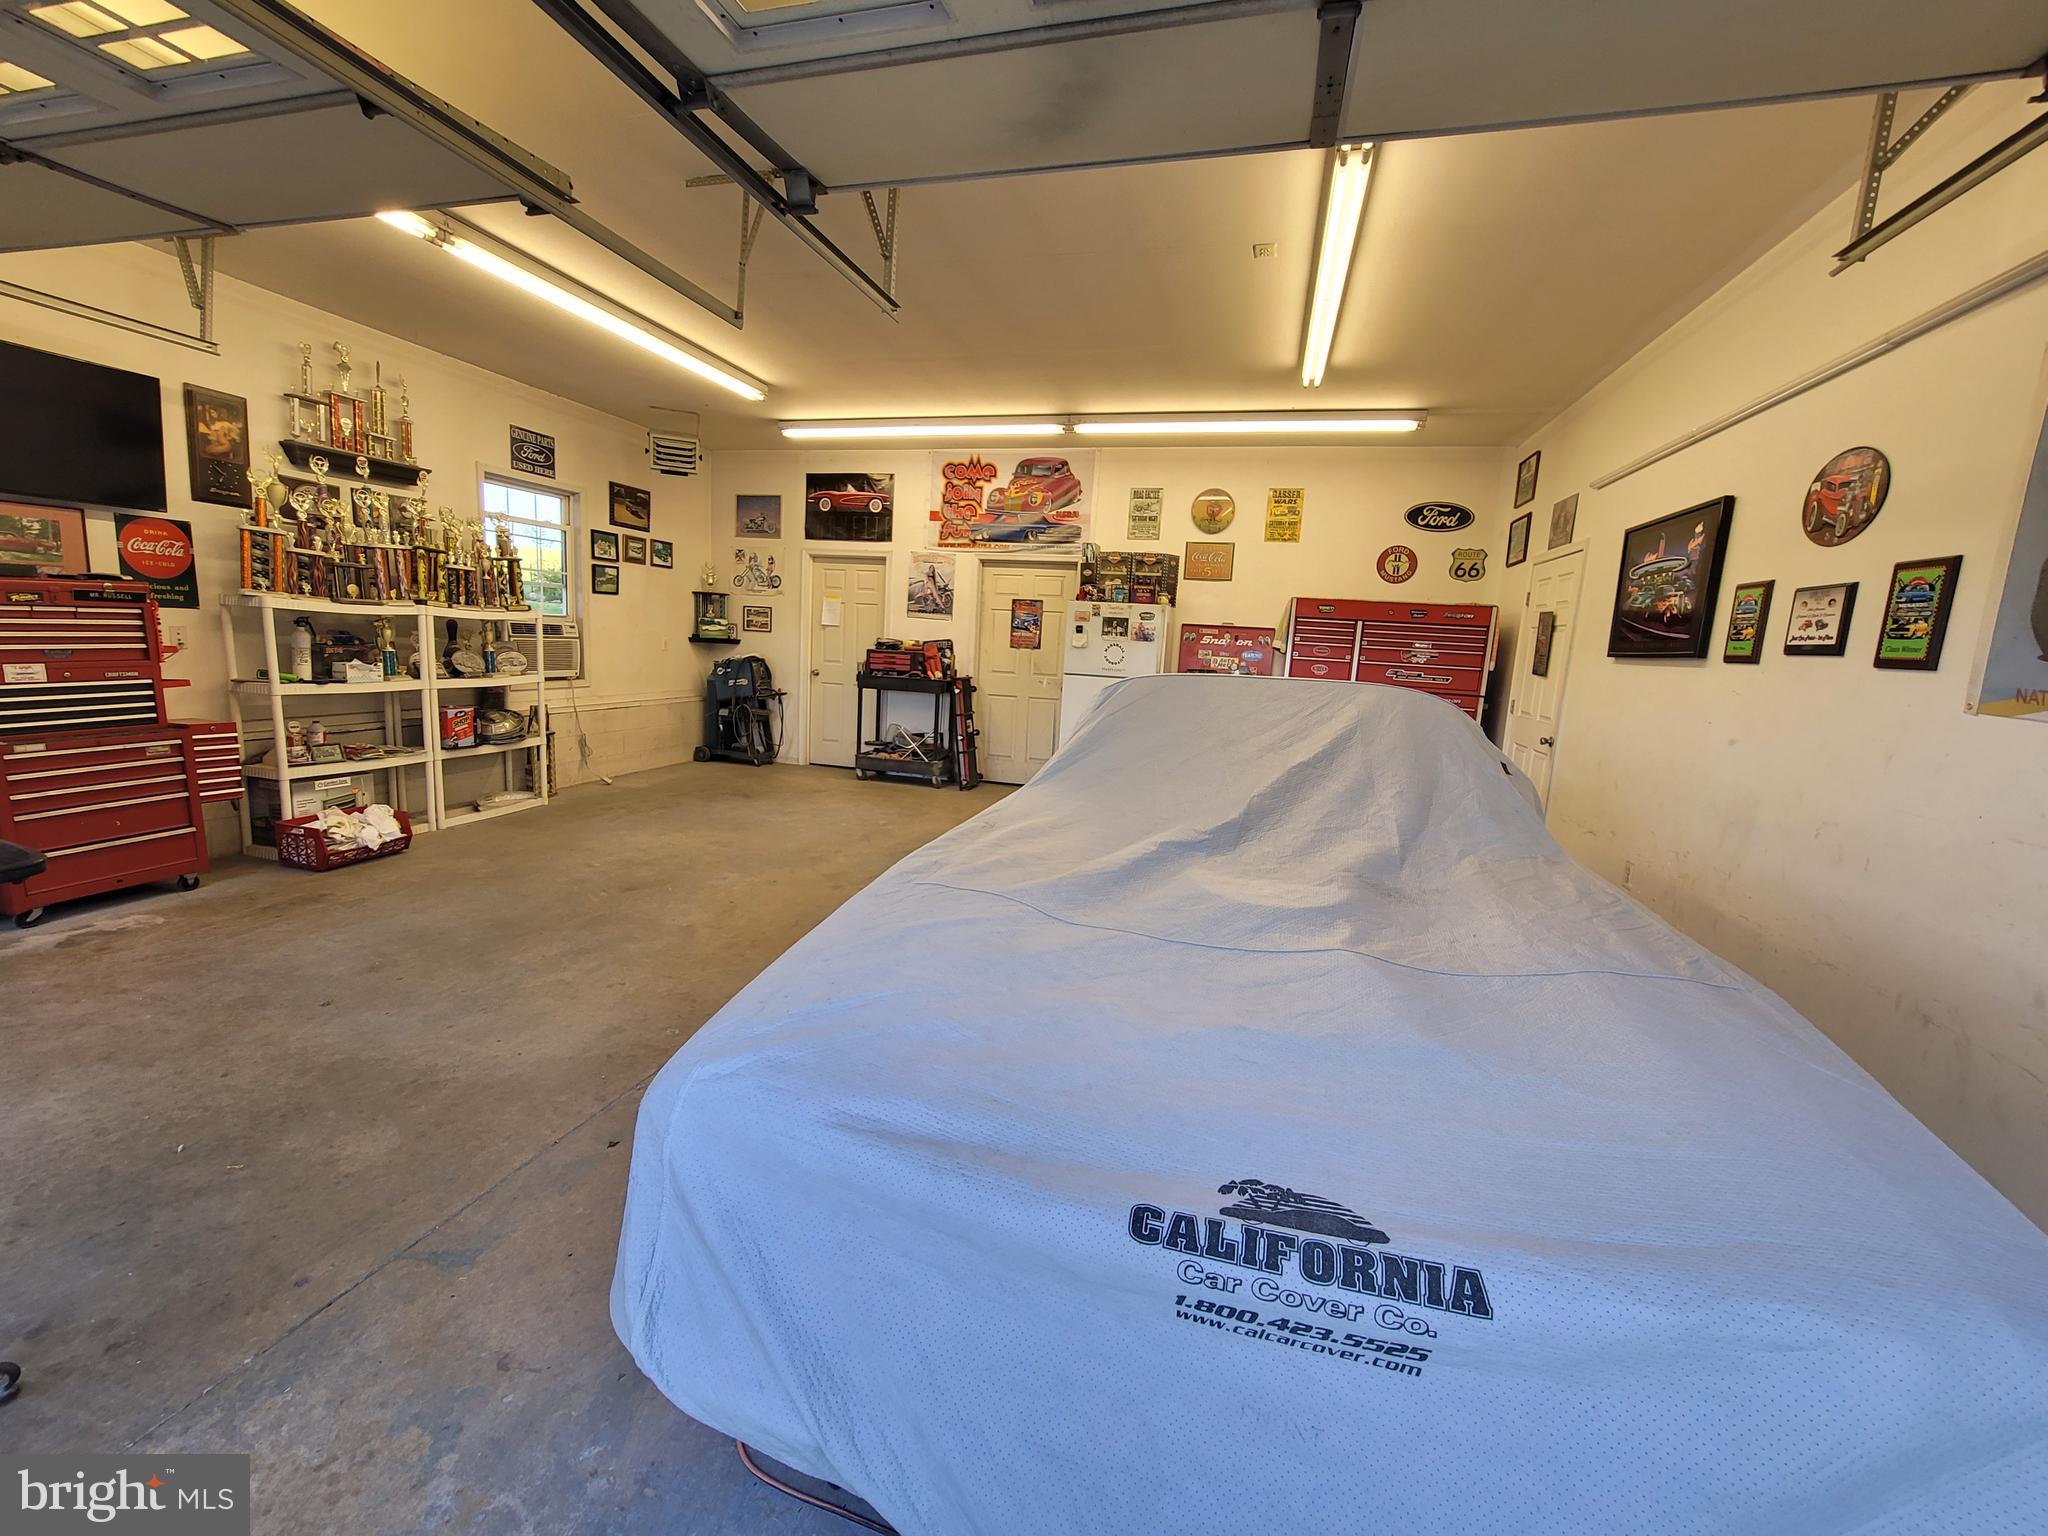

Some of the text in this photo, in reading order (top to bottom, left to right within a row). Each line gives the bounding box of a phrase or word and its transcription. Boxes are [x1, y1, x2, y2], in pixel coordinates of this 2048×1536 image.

[520, 445, 547, 463] Ford
[513, 460, 534, 472] USED
[1418, 505, 1461, 527] Ford
[1388, 546, 1410, 555] FORD
[1458, 551, 1481, 559] ROUTE
[1380, 569, 1412, 583] MUSTANG
[1454, 562, 1480, 578] 66
[149, 583, 171, 591] cious
[1127, 1203, 1494, 1320] CALIFORNIA
[1176, 1260, 1438, 1339] Car Cover Co.
[1174, 1294, 1433, 1363] 1.800.423.5525
[1175, 1310, 1423, 1378] www.calcarcover.com
